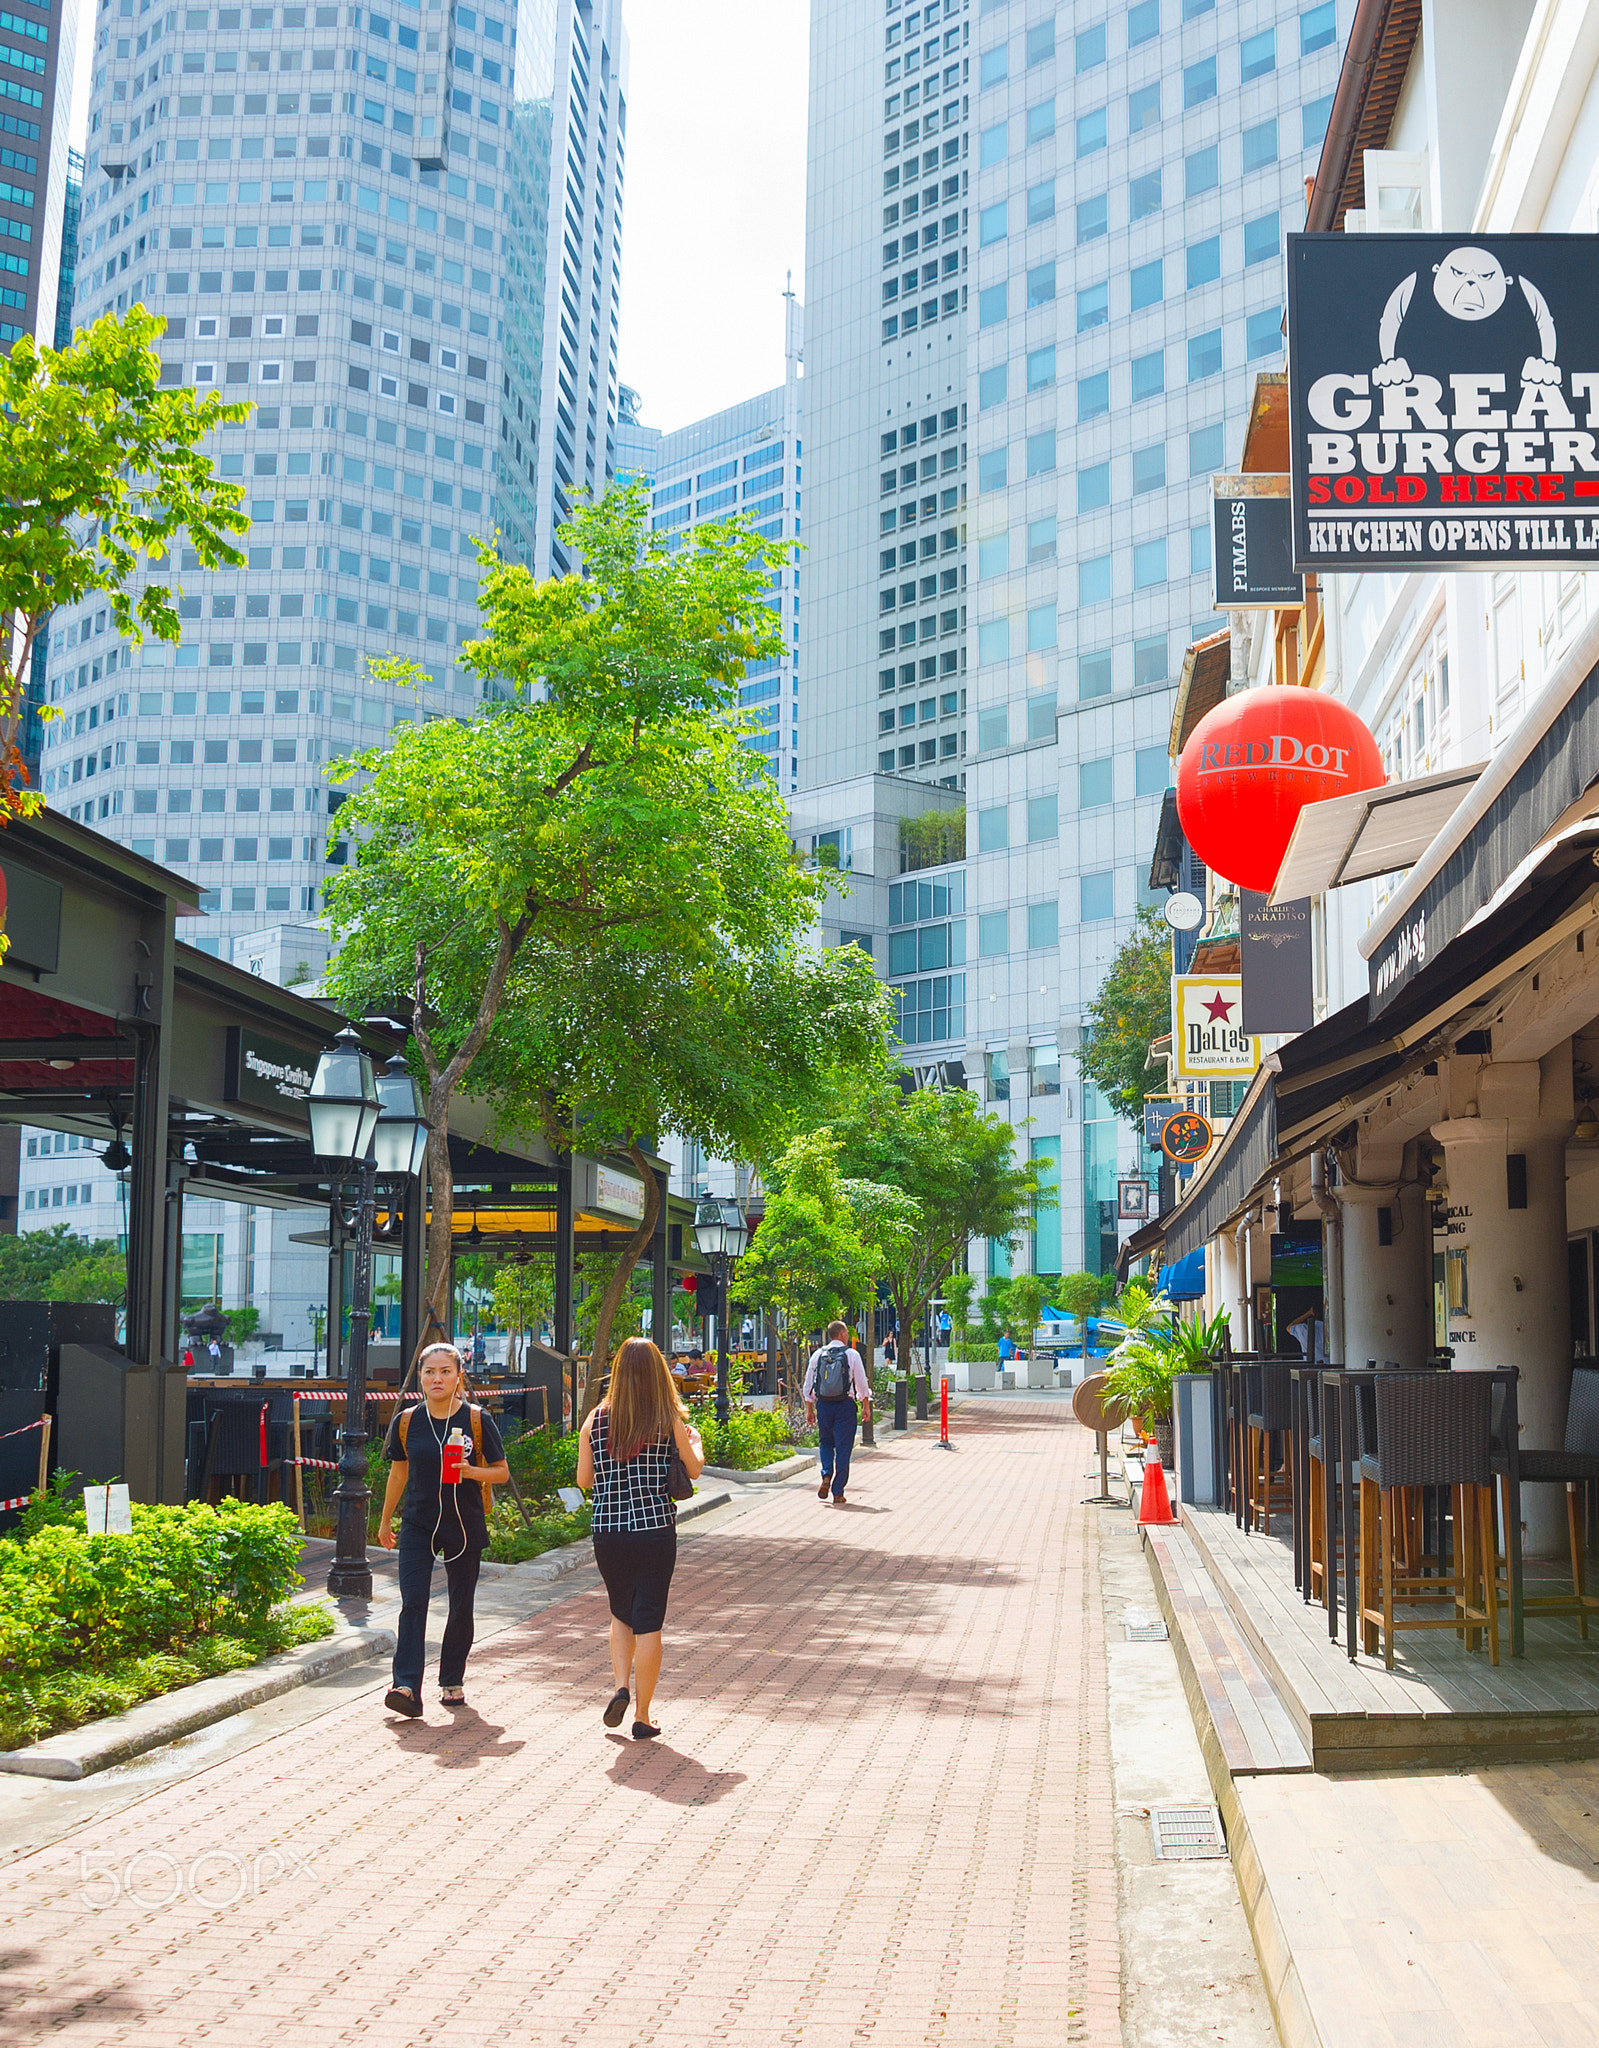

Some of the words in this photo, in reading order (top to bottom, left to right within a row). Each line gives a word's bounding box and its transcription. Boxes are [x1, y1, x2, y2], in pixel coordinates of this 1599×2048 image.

[1308, 476, 1427, 503] SOLD
[1440, 474, 1565, 502] HERE
[1231, 501, 1248, 593] PIMABS
[1309, 520, 1422, 552] KITCHEN
[1428, 519, 1512, 551] OPENS
[1515, 519, 1571, 550] TILL
[1202, 770, 1341, 789] BREWHOUSE
[1248, 912, 1306, 921] PARADISO
[245, 1050, 284, 1080] Singapore
[1189, 1056, 1228, 1064] RESTAURANT
[1229, 1056, 1234, 1064] &
